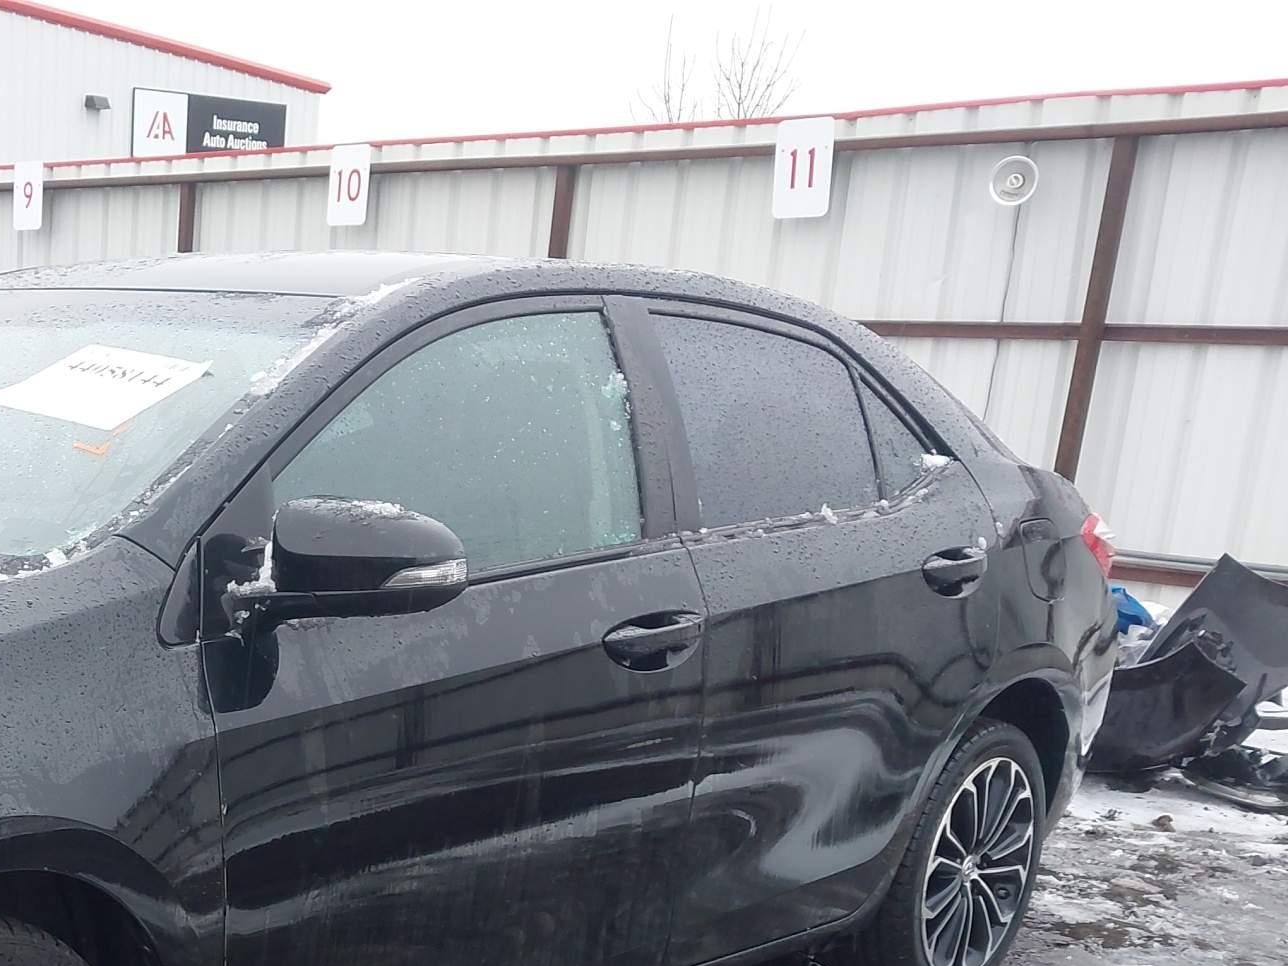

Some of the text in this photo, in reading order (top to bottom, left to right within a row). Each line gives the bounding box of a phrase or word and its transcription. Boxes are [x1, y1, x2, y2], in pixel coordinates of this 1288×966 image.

[213, 114, 259, 134] Insurance
[202, 131, 268, 150] Auto Auctions
[790, 147, 816, 189] 11
[24, 181, 33, 209] 9
[336, 168, 361, 203] 10
